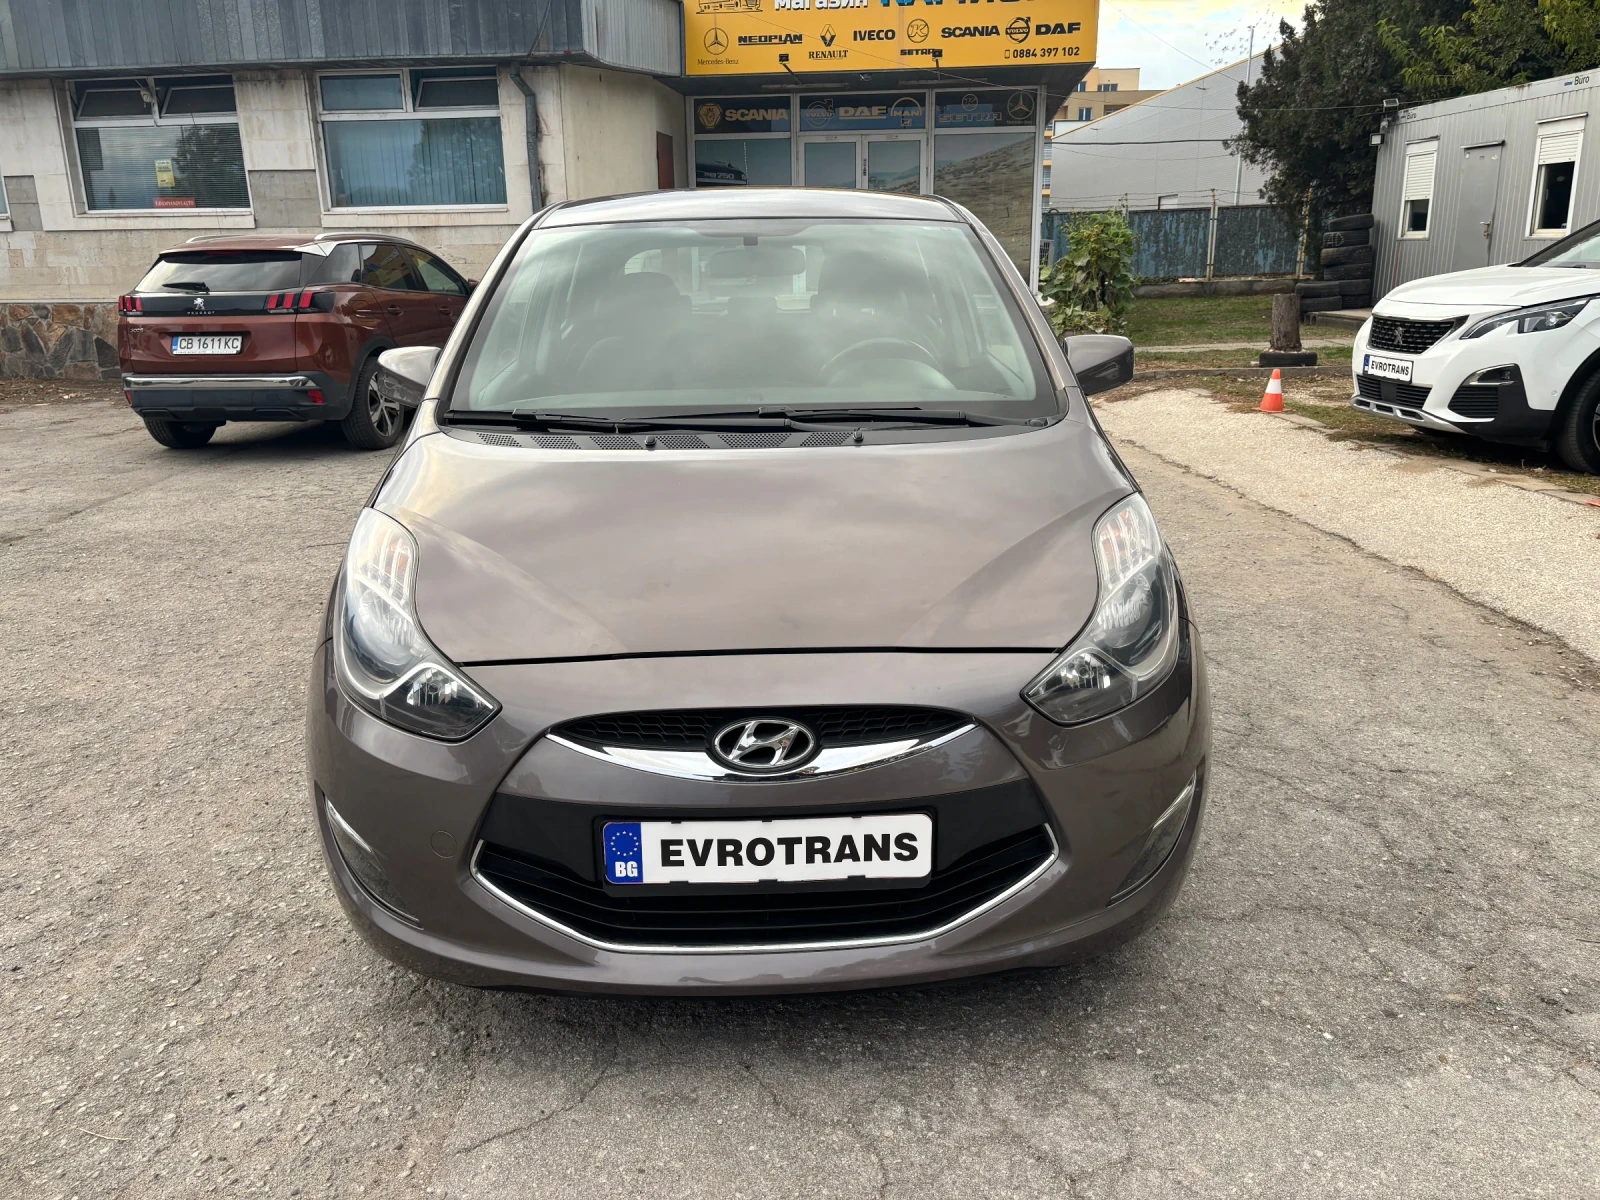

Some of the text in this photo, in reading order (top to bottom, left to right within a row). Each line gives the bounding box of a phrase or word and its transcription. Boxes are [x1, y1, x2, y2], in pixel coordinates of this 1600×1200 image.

[853, 29, 896, 41] IVECO
[941, 25, 1000, 38] SCANIA
[1035, 22, 1081, 36] DAF
[738, 34, 803, 44] NEOPLAN
[808, 50, 849, 59] RENAULT
[1013, 46, 1080, 59] 0884 397 102
[697, 58, 740, 66] Mercedes-Benz
[1574, 75, 1590, 85] Büro
[725, 108, 788, 121] SCANIA
[839, 106, 887, 116] DAF
[179, 337, 240, 350] CB 1611 KC
[1371, 360, 1410, 376] EVROTRANS
[660, 832, 919, 867] EVROTRANS
[614, 862, 639, 878] BG
